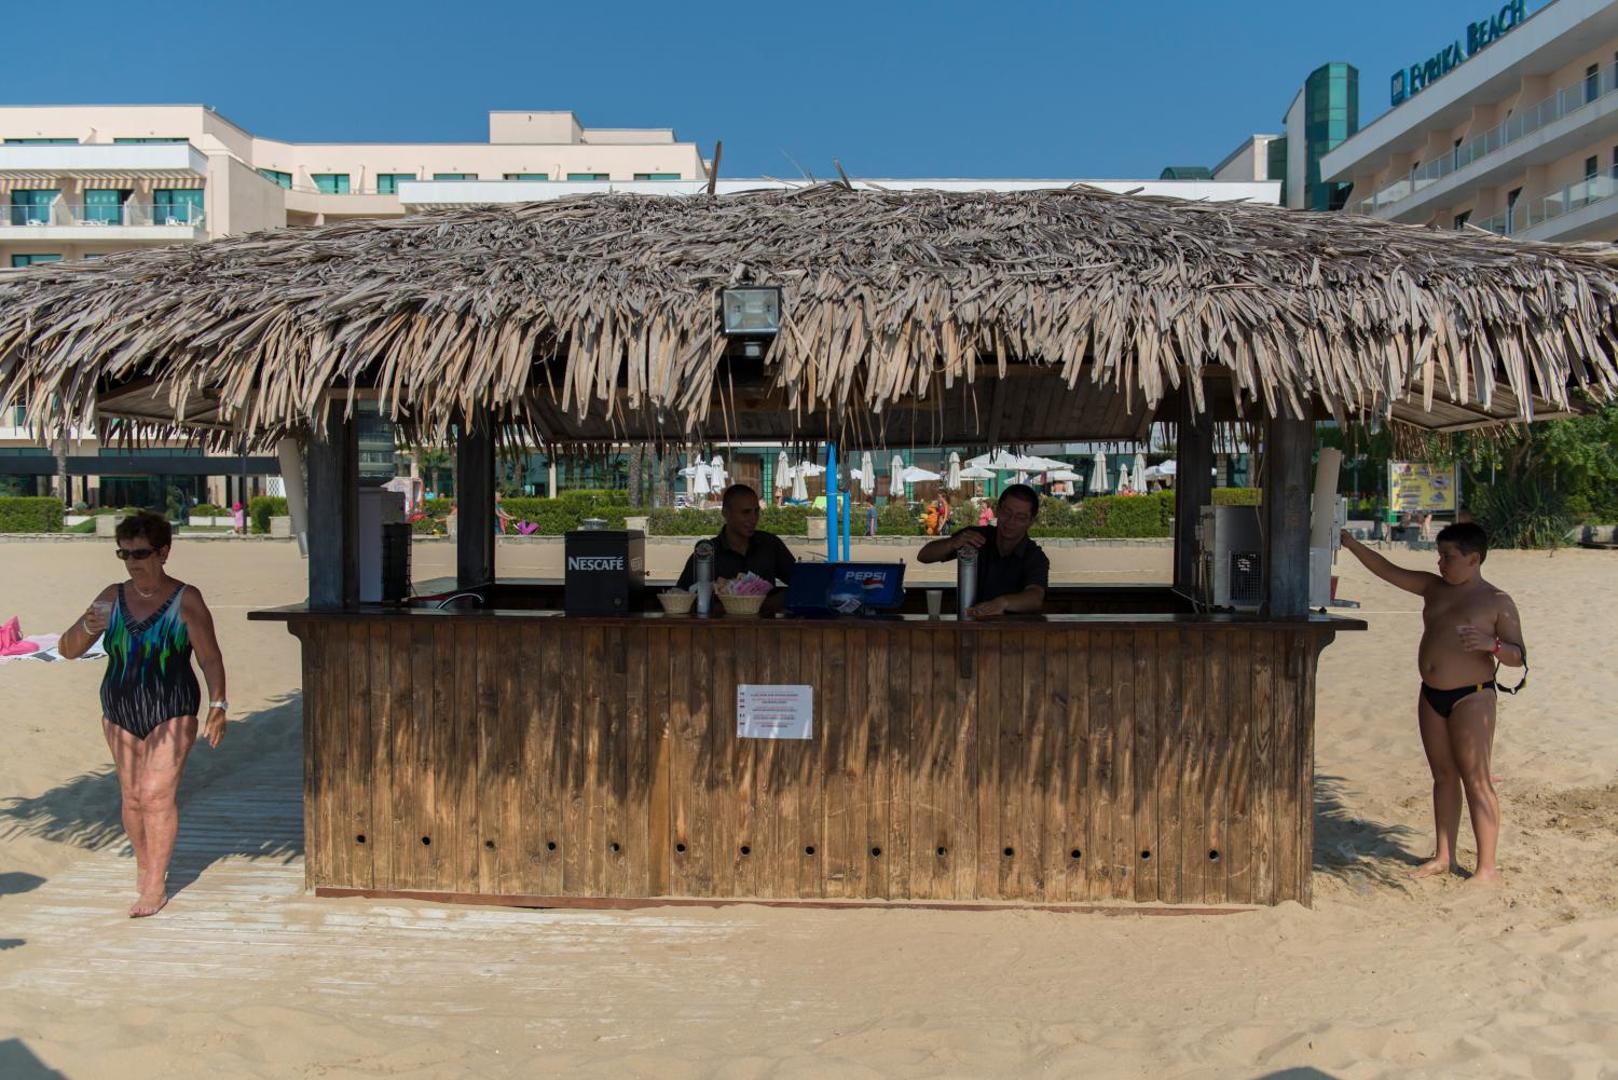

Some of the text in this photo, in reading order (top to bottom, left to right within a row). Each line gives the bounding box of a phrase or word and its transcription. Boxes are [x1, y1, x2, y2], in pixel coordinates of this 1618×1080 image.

[1467, 0, 1526, 56] BEACH
[568, 556, 624, 571] NESCAFÉ
[844, 570, 887, 582] PEPSI
